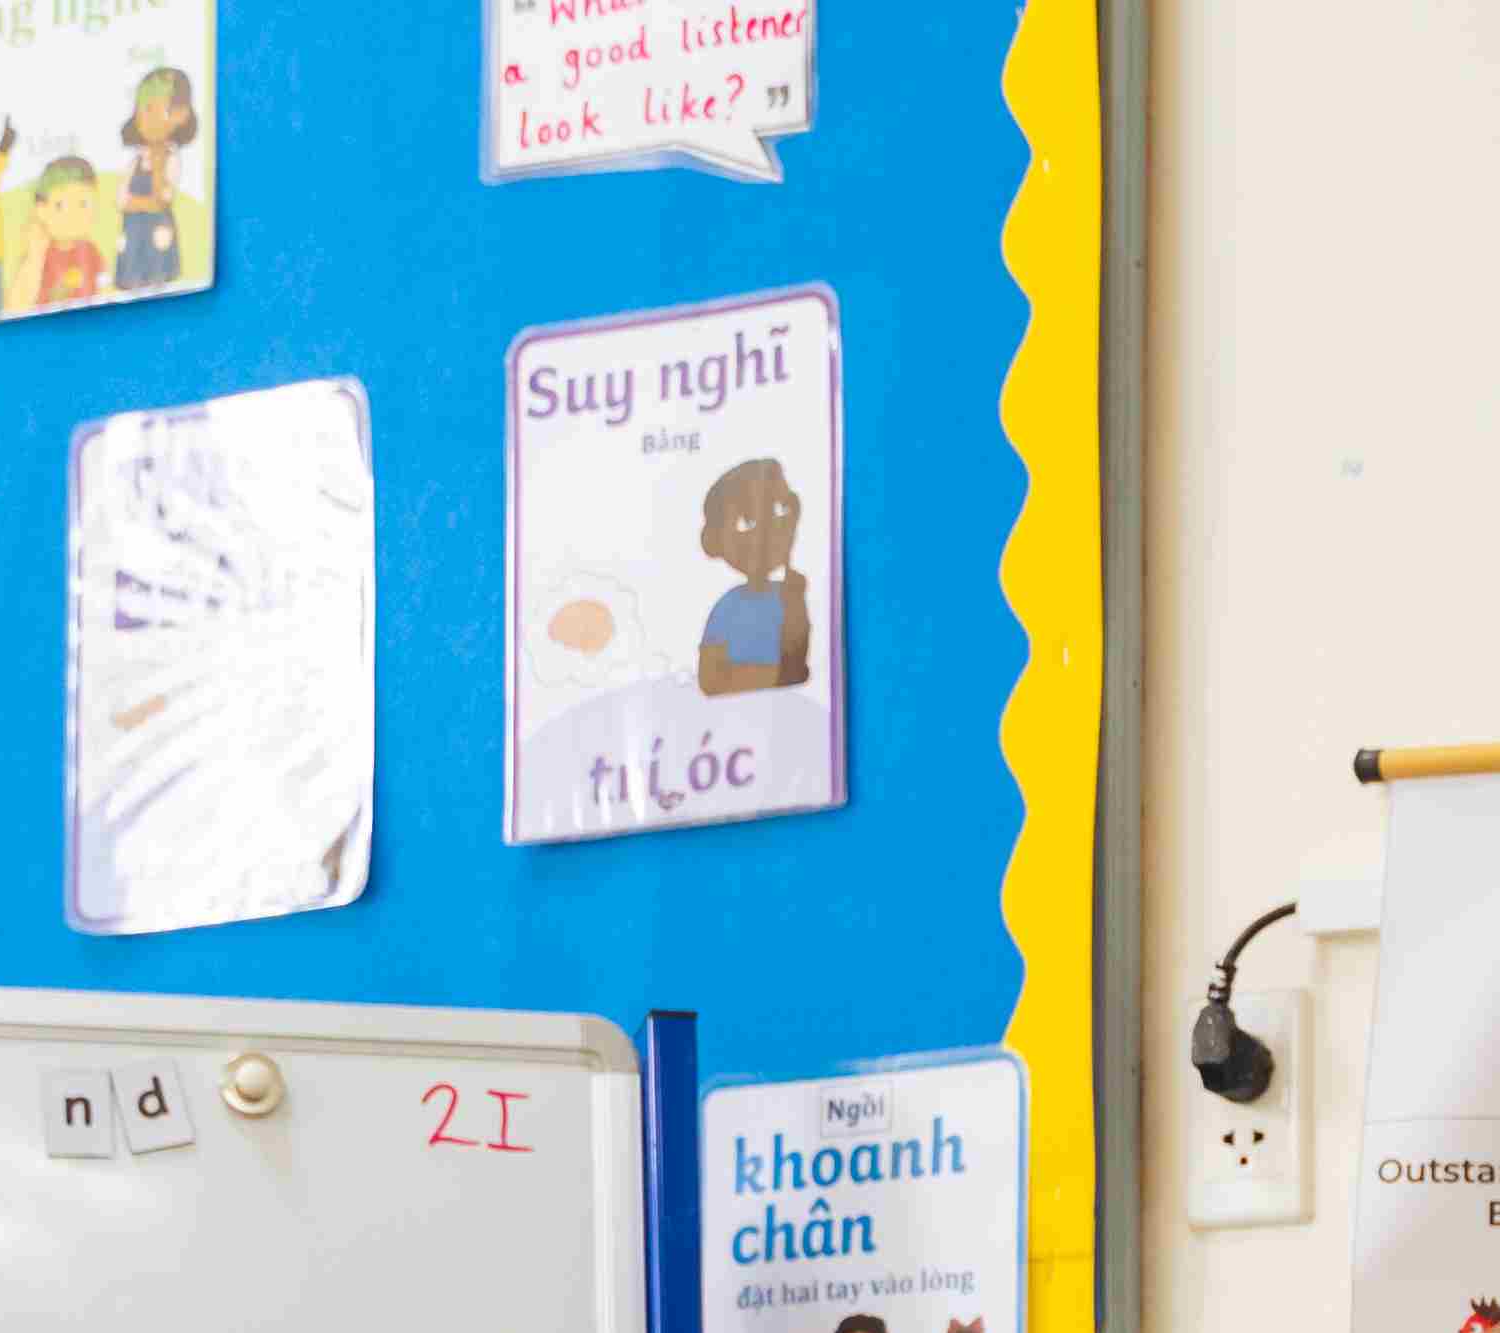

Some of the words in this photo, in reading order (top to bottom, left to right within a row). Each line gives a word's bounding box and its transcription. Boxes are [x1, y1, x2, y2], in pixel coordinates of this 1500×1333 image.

[503, 63, 525, 85] a
[563, 25, 651, 90] good
[682, 5, 808, 53] listener
[519, 101, 602, 148] look
[643, 73, 746, 124] like?
[527, 366, 634, 426] Suy
[660, 325, 790, 413] nghĩ
[687, 729, 755, 793] óc
[65, 1093, 92, 1126] n
[138, 1075, 169, 1118] d
[827, 1092, 885, 1128] Ngồi
[734, 1115, 967, 1196] khoanh
[732, 1197, 876, 1265] chân
[781, 1280, 819, 1305] hai
[826, 1279, 863, 1305] tay
[870, 1268, 914, 1296] vào
[920, 1266, 976, 1296] lòng
